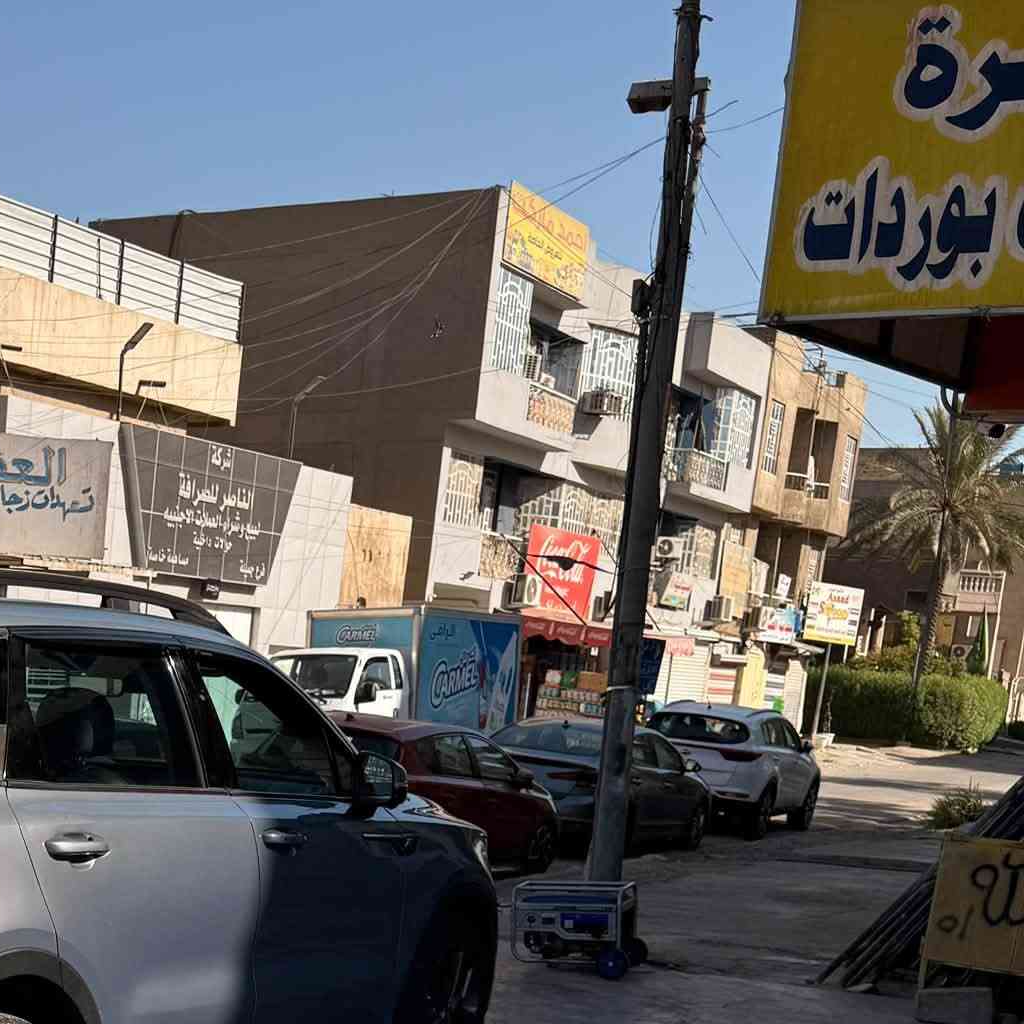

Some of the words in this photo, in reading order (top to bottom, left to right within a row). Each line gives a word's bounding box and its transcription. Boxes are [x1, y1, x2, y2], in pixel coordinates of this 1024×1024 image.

[904, 16, 1024, 131] رة
[803, 167, 996, 281] بوردات
[211, 446, 232, 470] شركة
[178, 472, 219, 507] للصرافة
[431, 659, 480, 709] CARMEL
